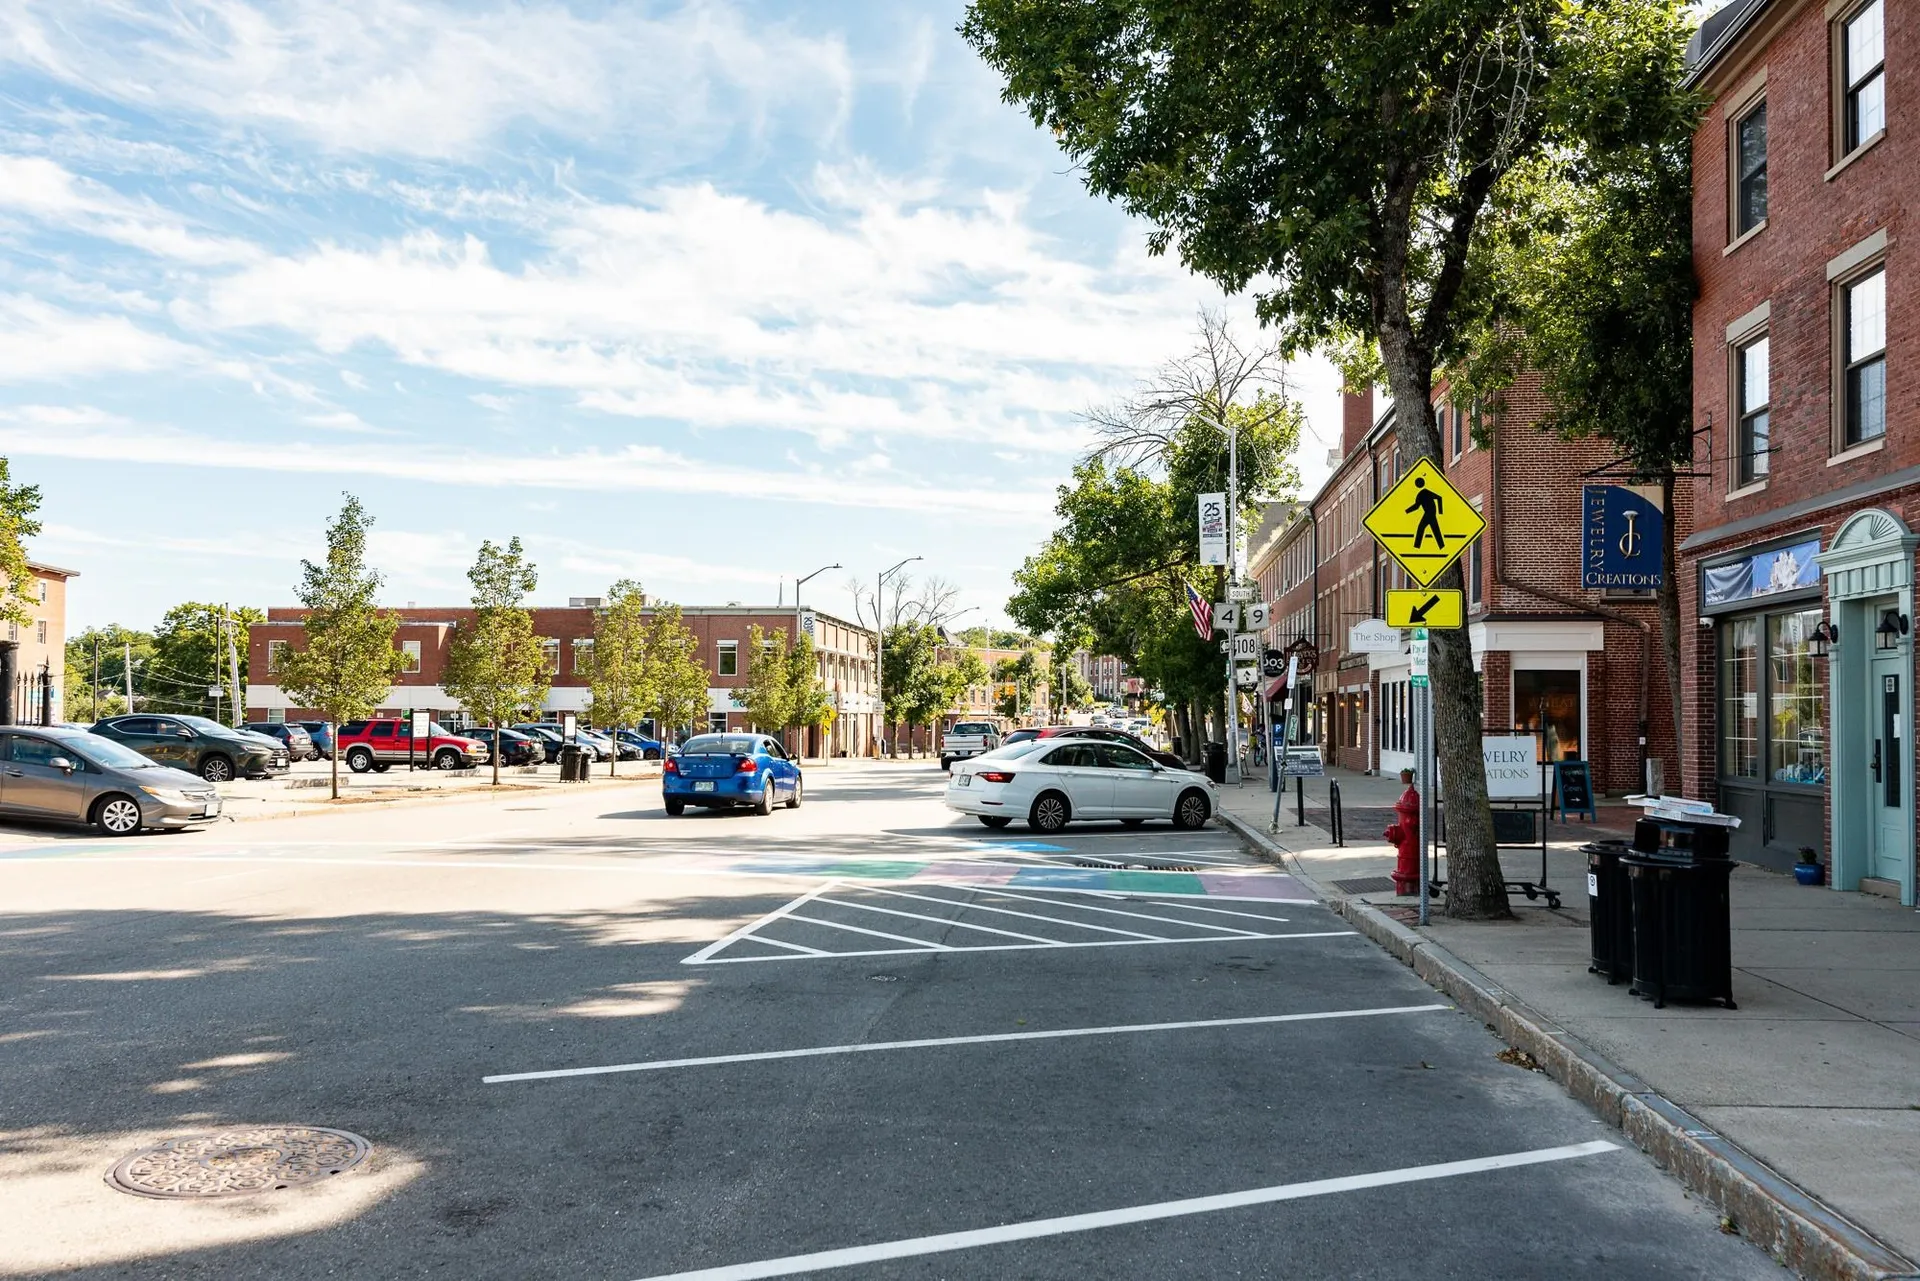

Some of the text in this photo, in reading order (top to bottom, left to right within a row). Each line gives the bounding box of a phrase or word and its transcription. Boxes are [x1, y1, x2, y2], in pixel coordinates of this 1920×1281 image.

[1204, 502, 1220, 517] 25
[1586, 489, 1607, 573] JEWELRY
[1232, 590, 1250, 598] SOUTH
[1221, 609, 1234, 624] 4
[1253, 609, 1263, 624] 9
[1353, 632, 1397, 643] The Shop
[1237, 638, 1256, 654] 108
[1486, 768, 1529, 779] ATIONS
